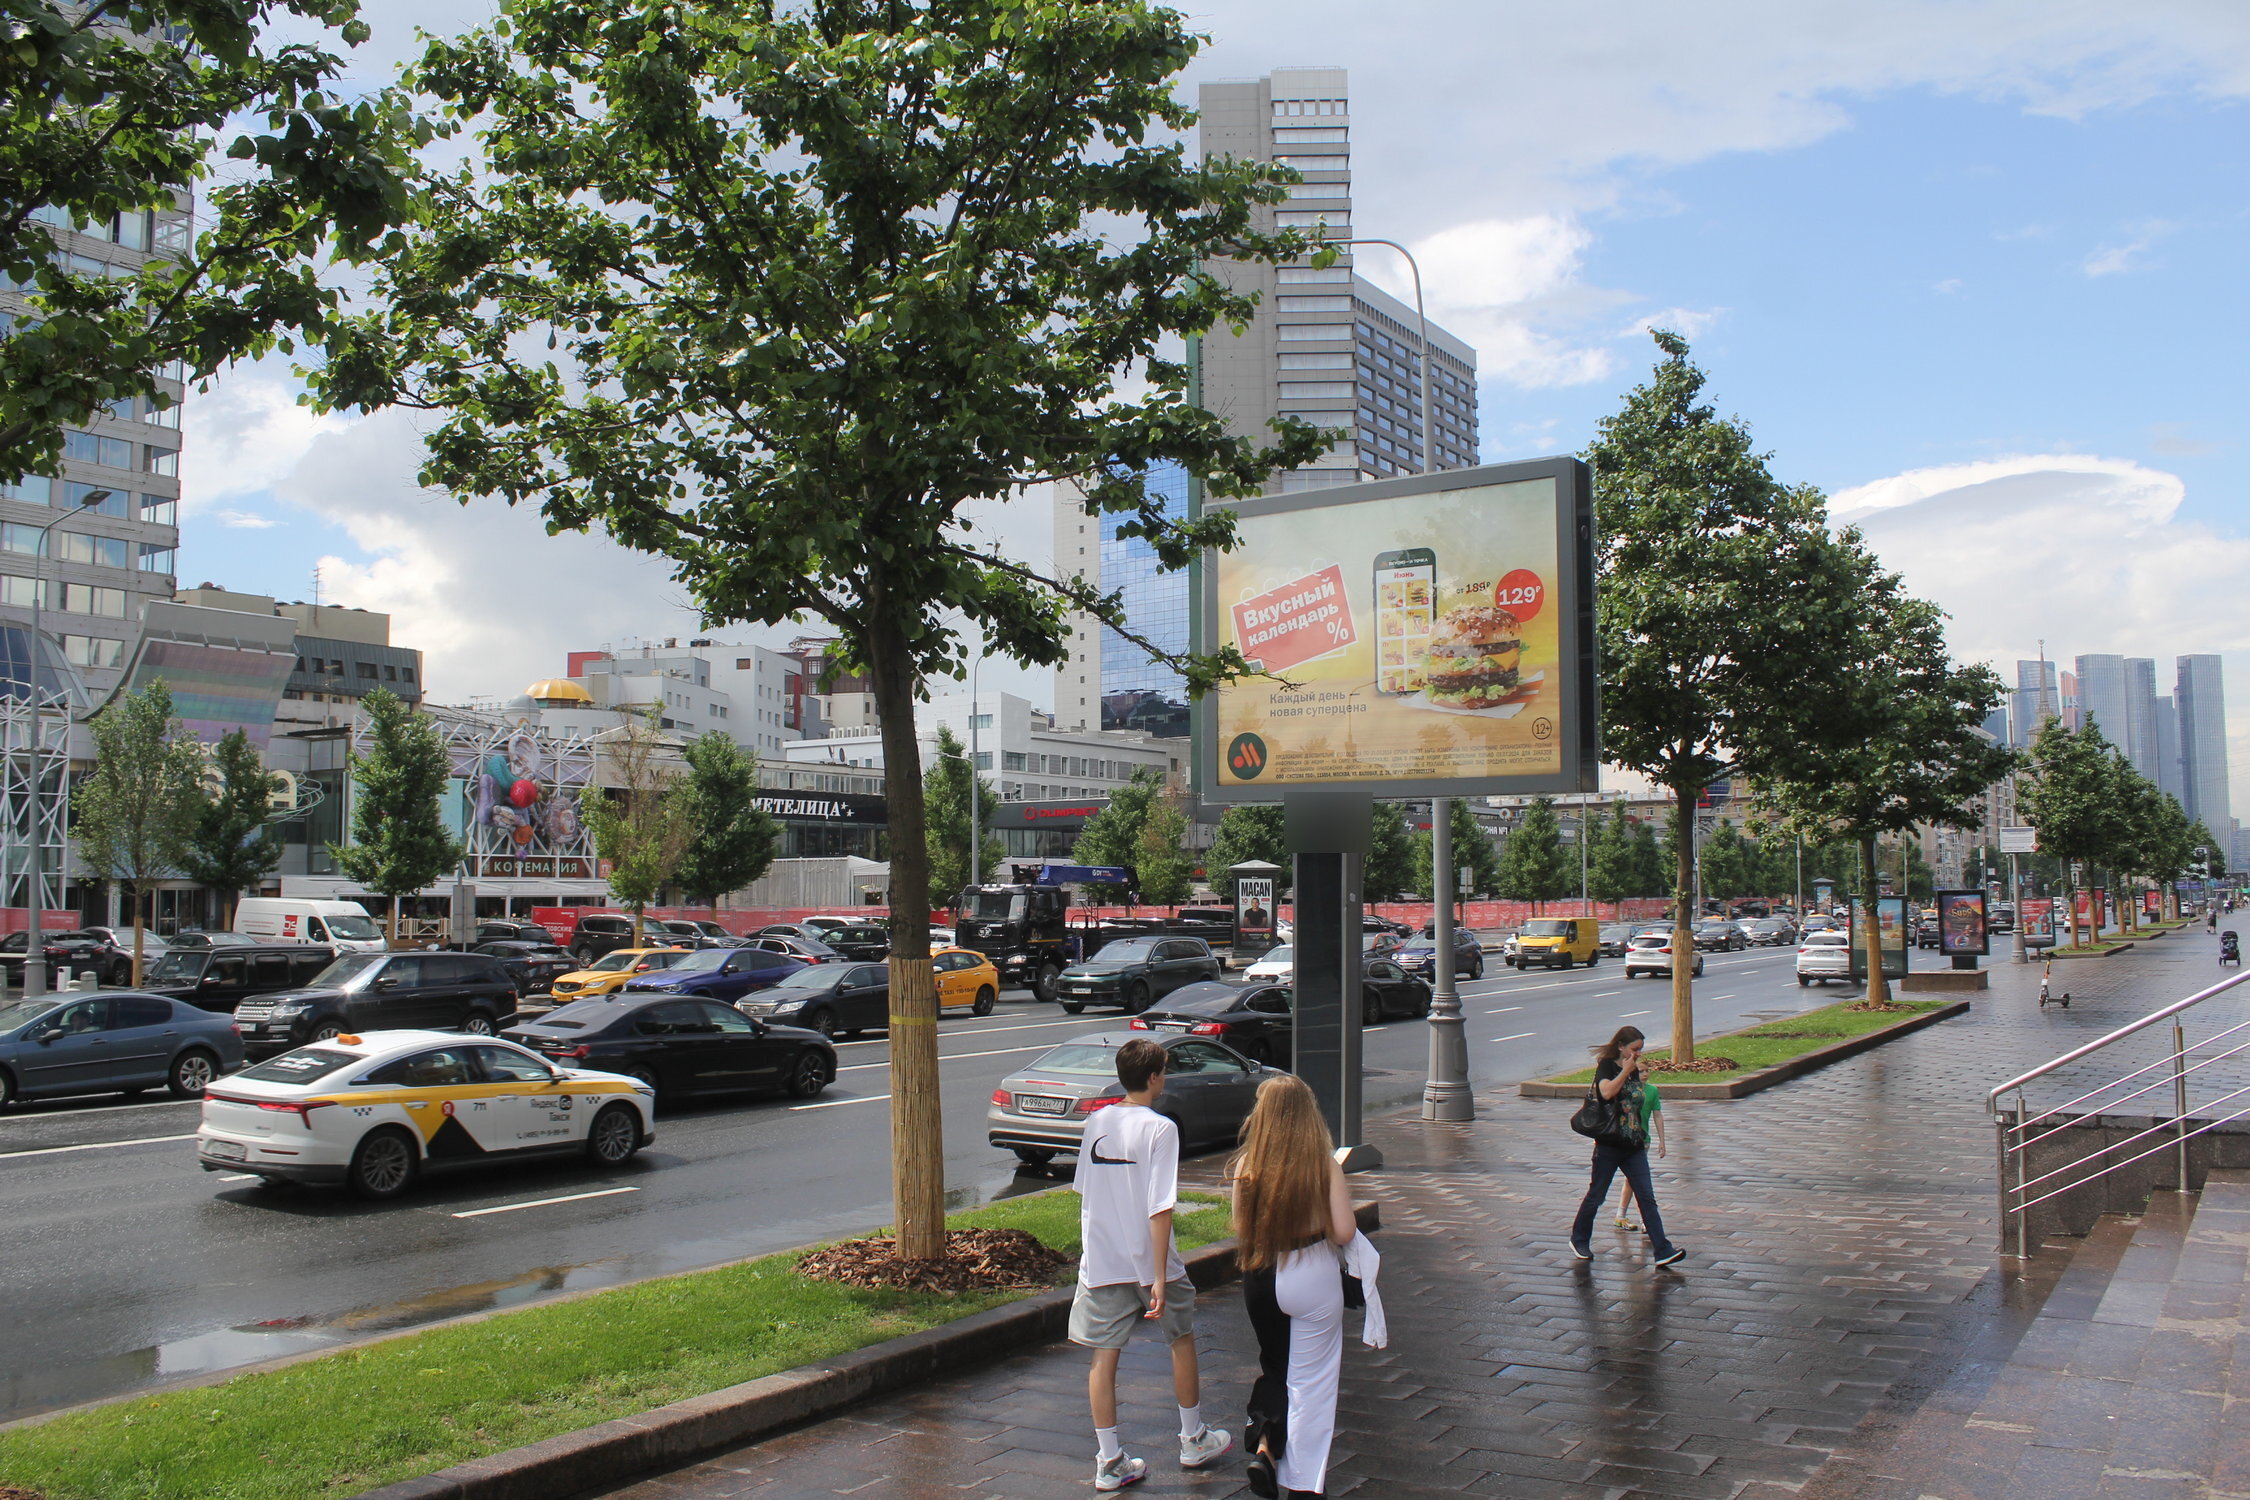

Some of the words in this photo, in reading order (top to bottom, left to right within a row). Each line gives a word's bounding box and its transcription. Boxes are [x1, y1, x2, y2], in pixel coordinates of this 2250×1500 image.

[1243, 576, 1336, 630] Вкусный
[1248, 604, 1339, 647] календарь
[1270, 692, 1315, 704] Каждый
[1319, 692, 1346, 702] день
[1270, 707, 1303, 717] новая
[1306, 704, 1367, 717] суперцена
[1536, 723, 1551, 735] 12+
[1040, 807, 1100, 817] OLIMPBET
[1241, 882, 1270, 896] MACAN
[549, 1112, 570, 1121] Такси
